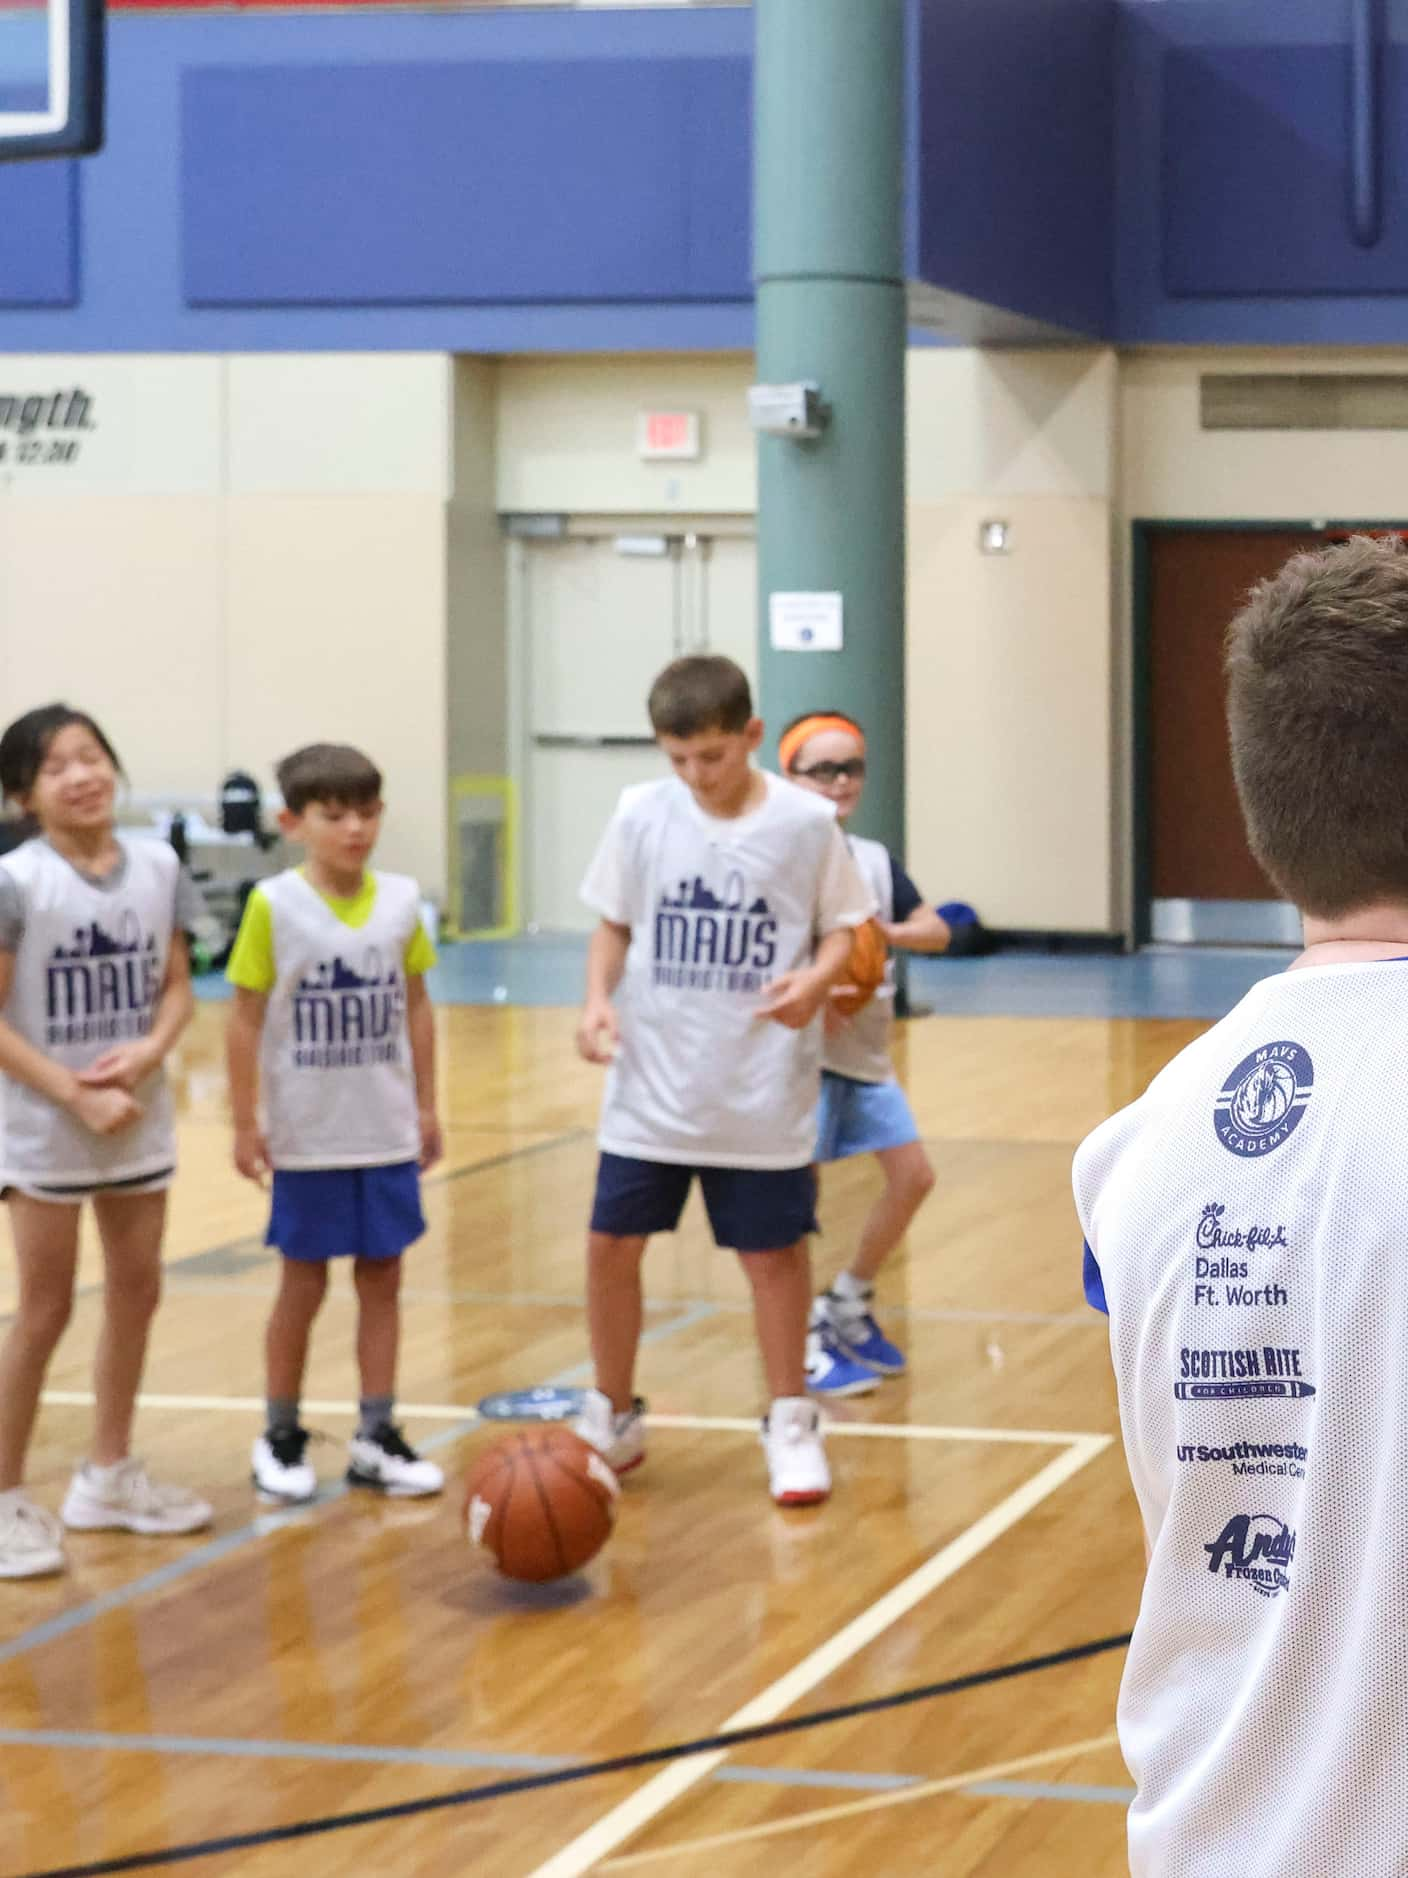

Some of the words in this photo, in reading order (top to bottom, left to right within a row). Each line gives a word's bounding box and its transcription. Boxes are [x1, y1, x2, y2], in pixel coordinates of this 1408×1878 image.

[655, 912, 777, 968] MAVS
[1255, 1045, 1298, 1064] MAVS
[1221, 1122, 1289, 1152] ACADEMY
[1195, 1257, 1248, 1279] Dallas
[1194, 1284, 1219, 1306] Ft.
[1226, 1284, 1288, 1306] Worth
[1180, 1347, 1261, 1379] SCOTTISH
[1262, 1346, 1303, 1377] RITE
[1220, 1383, 1282, 1395] CHILDREN
[1232, 1463, 1287, 1476] Medical
[1225, 1563, 1273, 1583] Frozen
